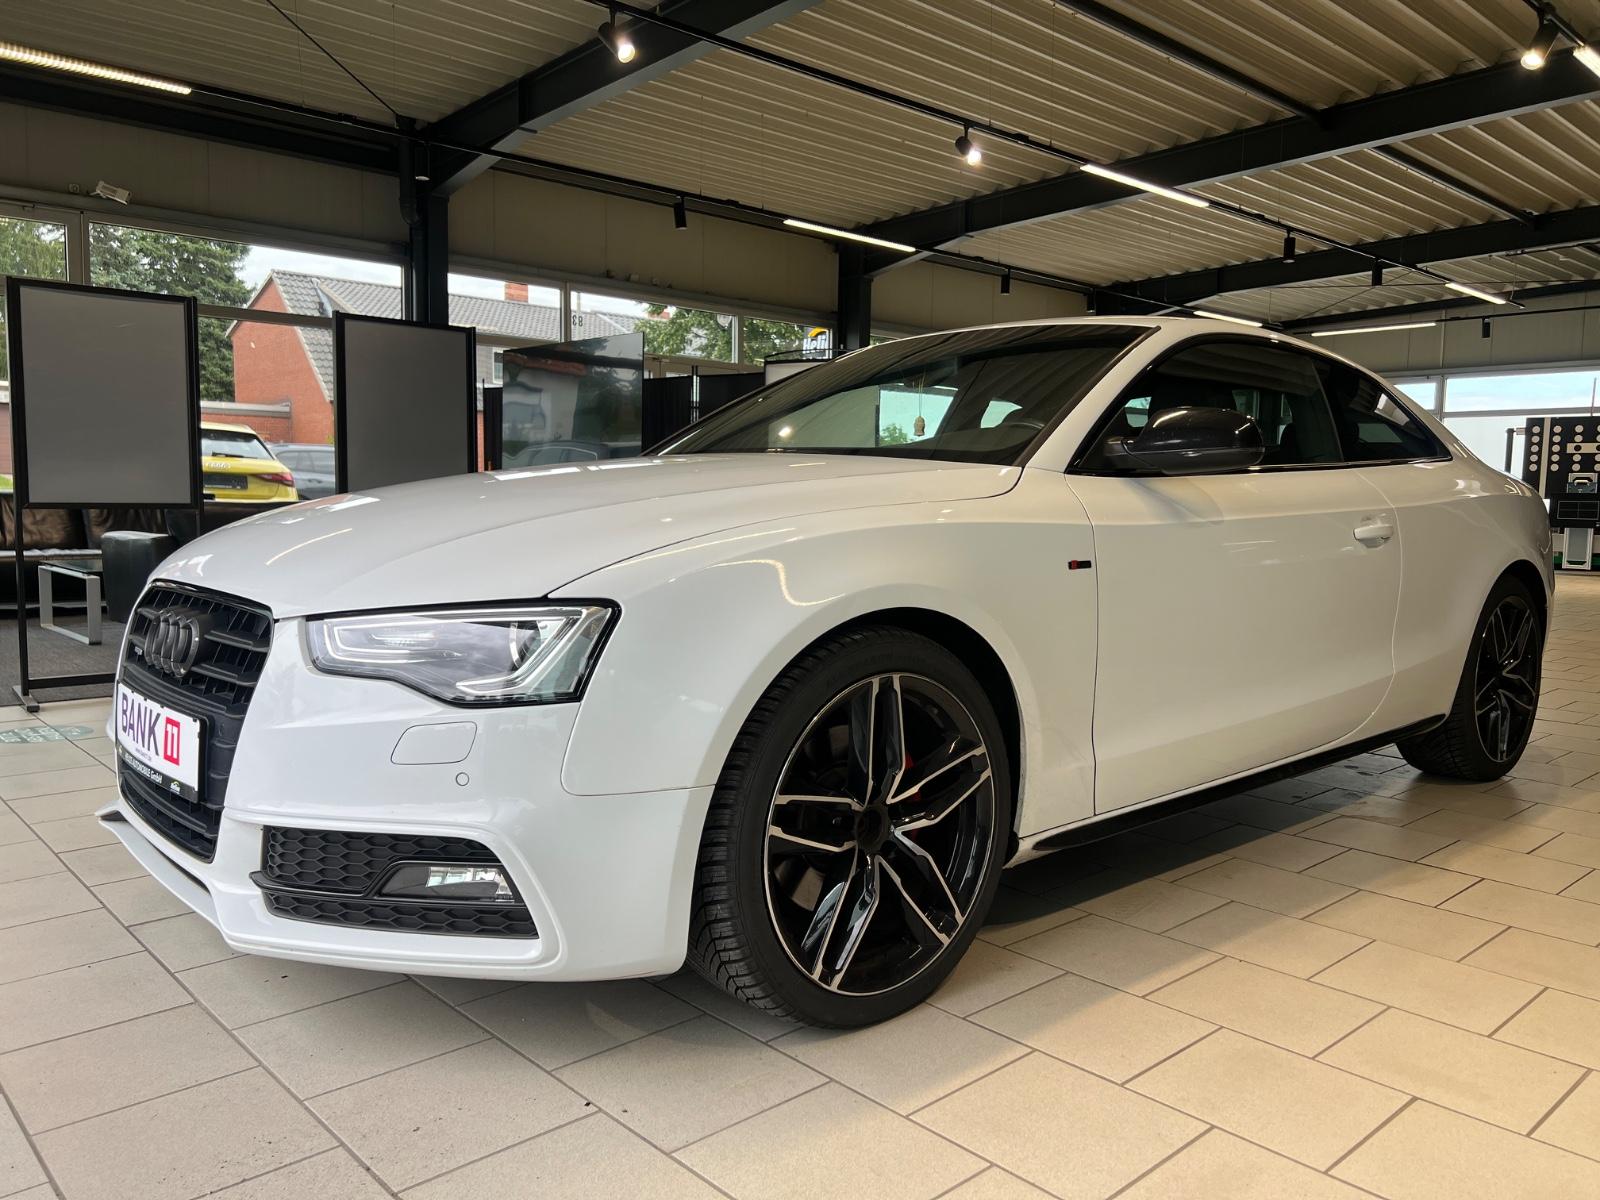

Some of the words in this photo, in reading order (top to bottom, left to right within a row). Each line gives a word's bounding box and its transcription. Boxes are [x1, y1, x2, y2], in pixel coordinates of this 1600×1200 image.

[803, 334, 829, 354] Heli
[121, 692, 161, 757] BANK
[165, 721, 179, 764] 11
